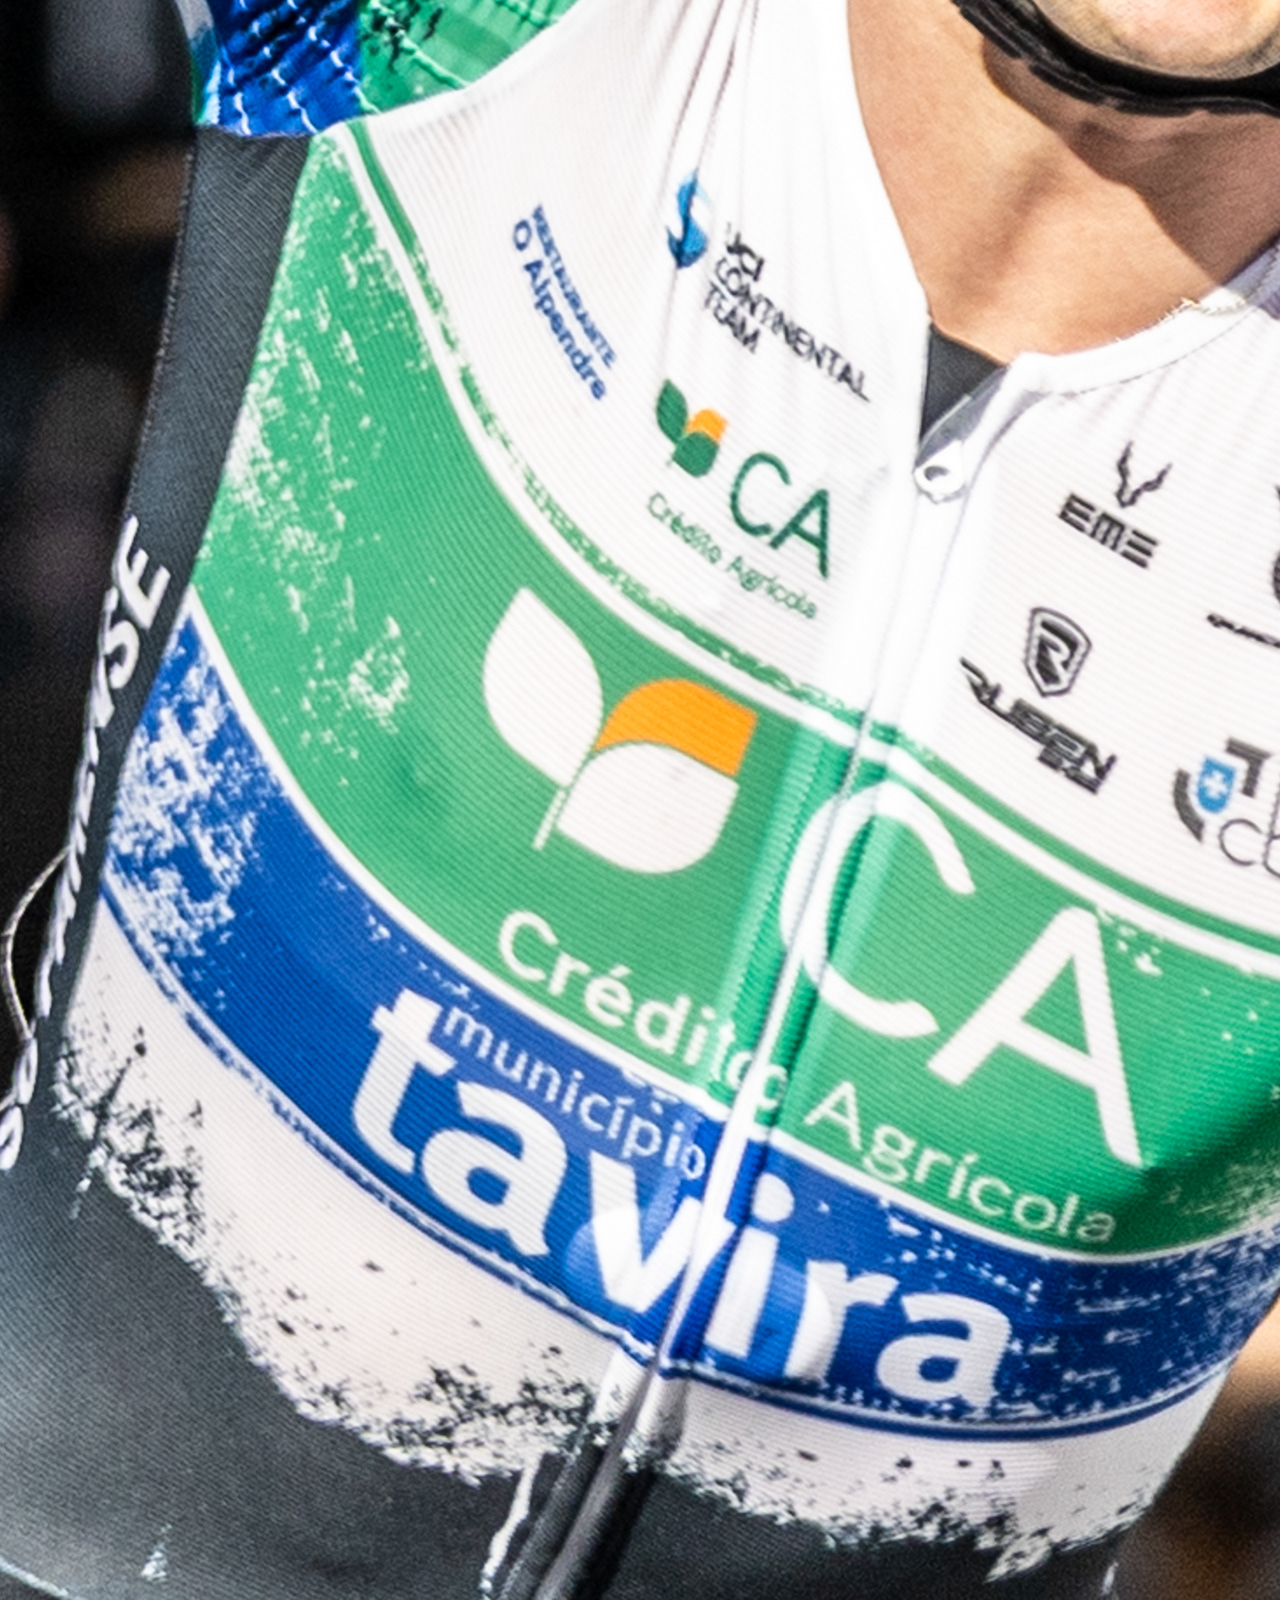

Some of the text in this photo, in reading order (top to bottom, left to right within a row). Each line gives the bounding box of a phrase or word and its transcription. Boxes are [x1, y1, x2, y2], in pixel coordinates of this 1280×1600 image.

[523, 259, 606, 400] Alpendre
[703, 279, 760, 354] TEAM
[714, 256, 872, 402] CONTINENTAL
[729, 451, 829, 579] CA
[779, 777, 1144, 1169] CA
[435, 1004, 707, 1181] município
[497, 908, 1118, 1245] Crédito Agrícola
[349, 986, 1013, 1408] tavira
